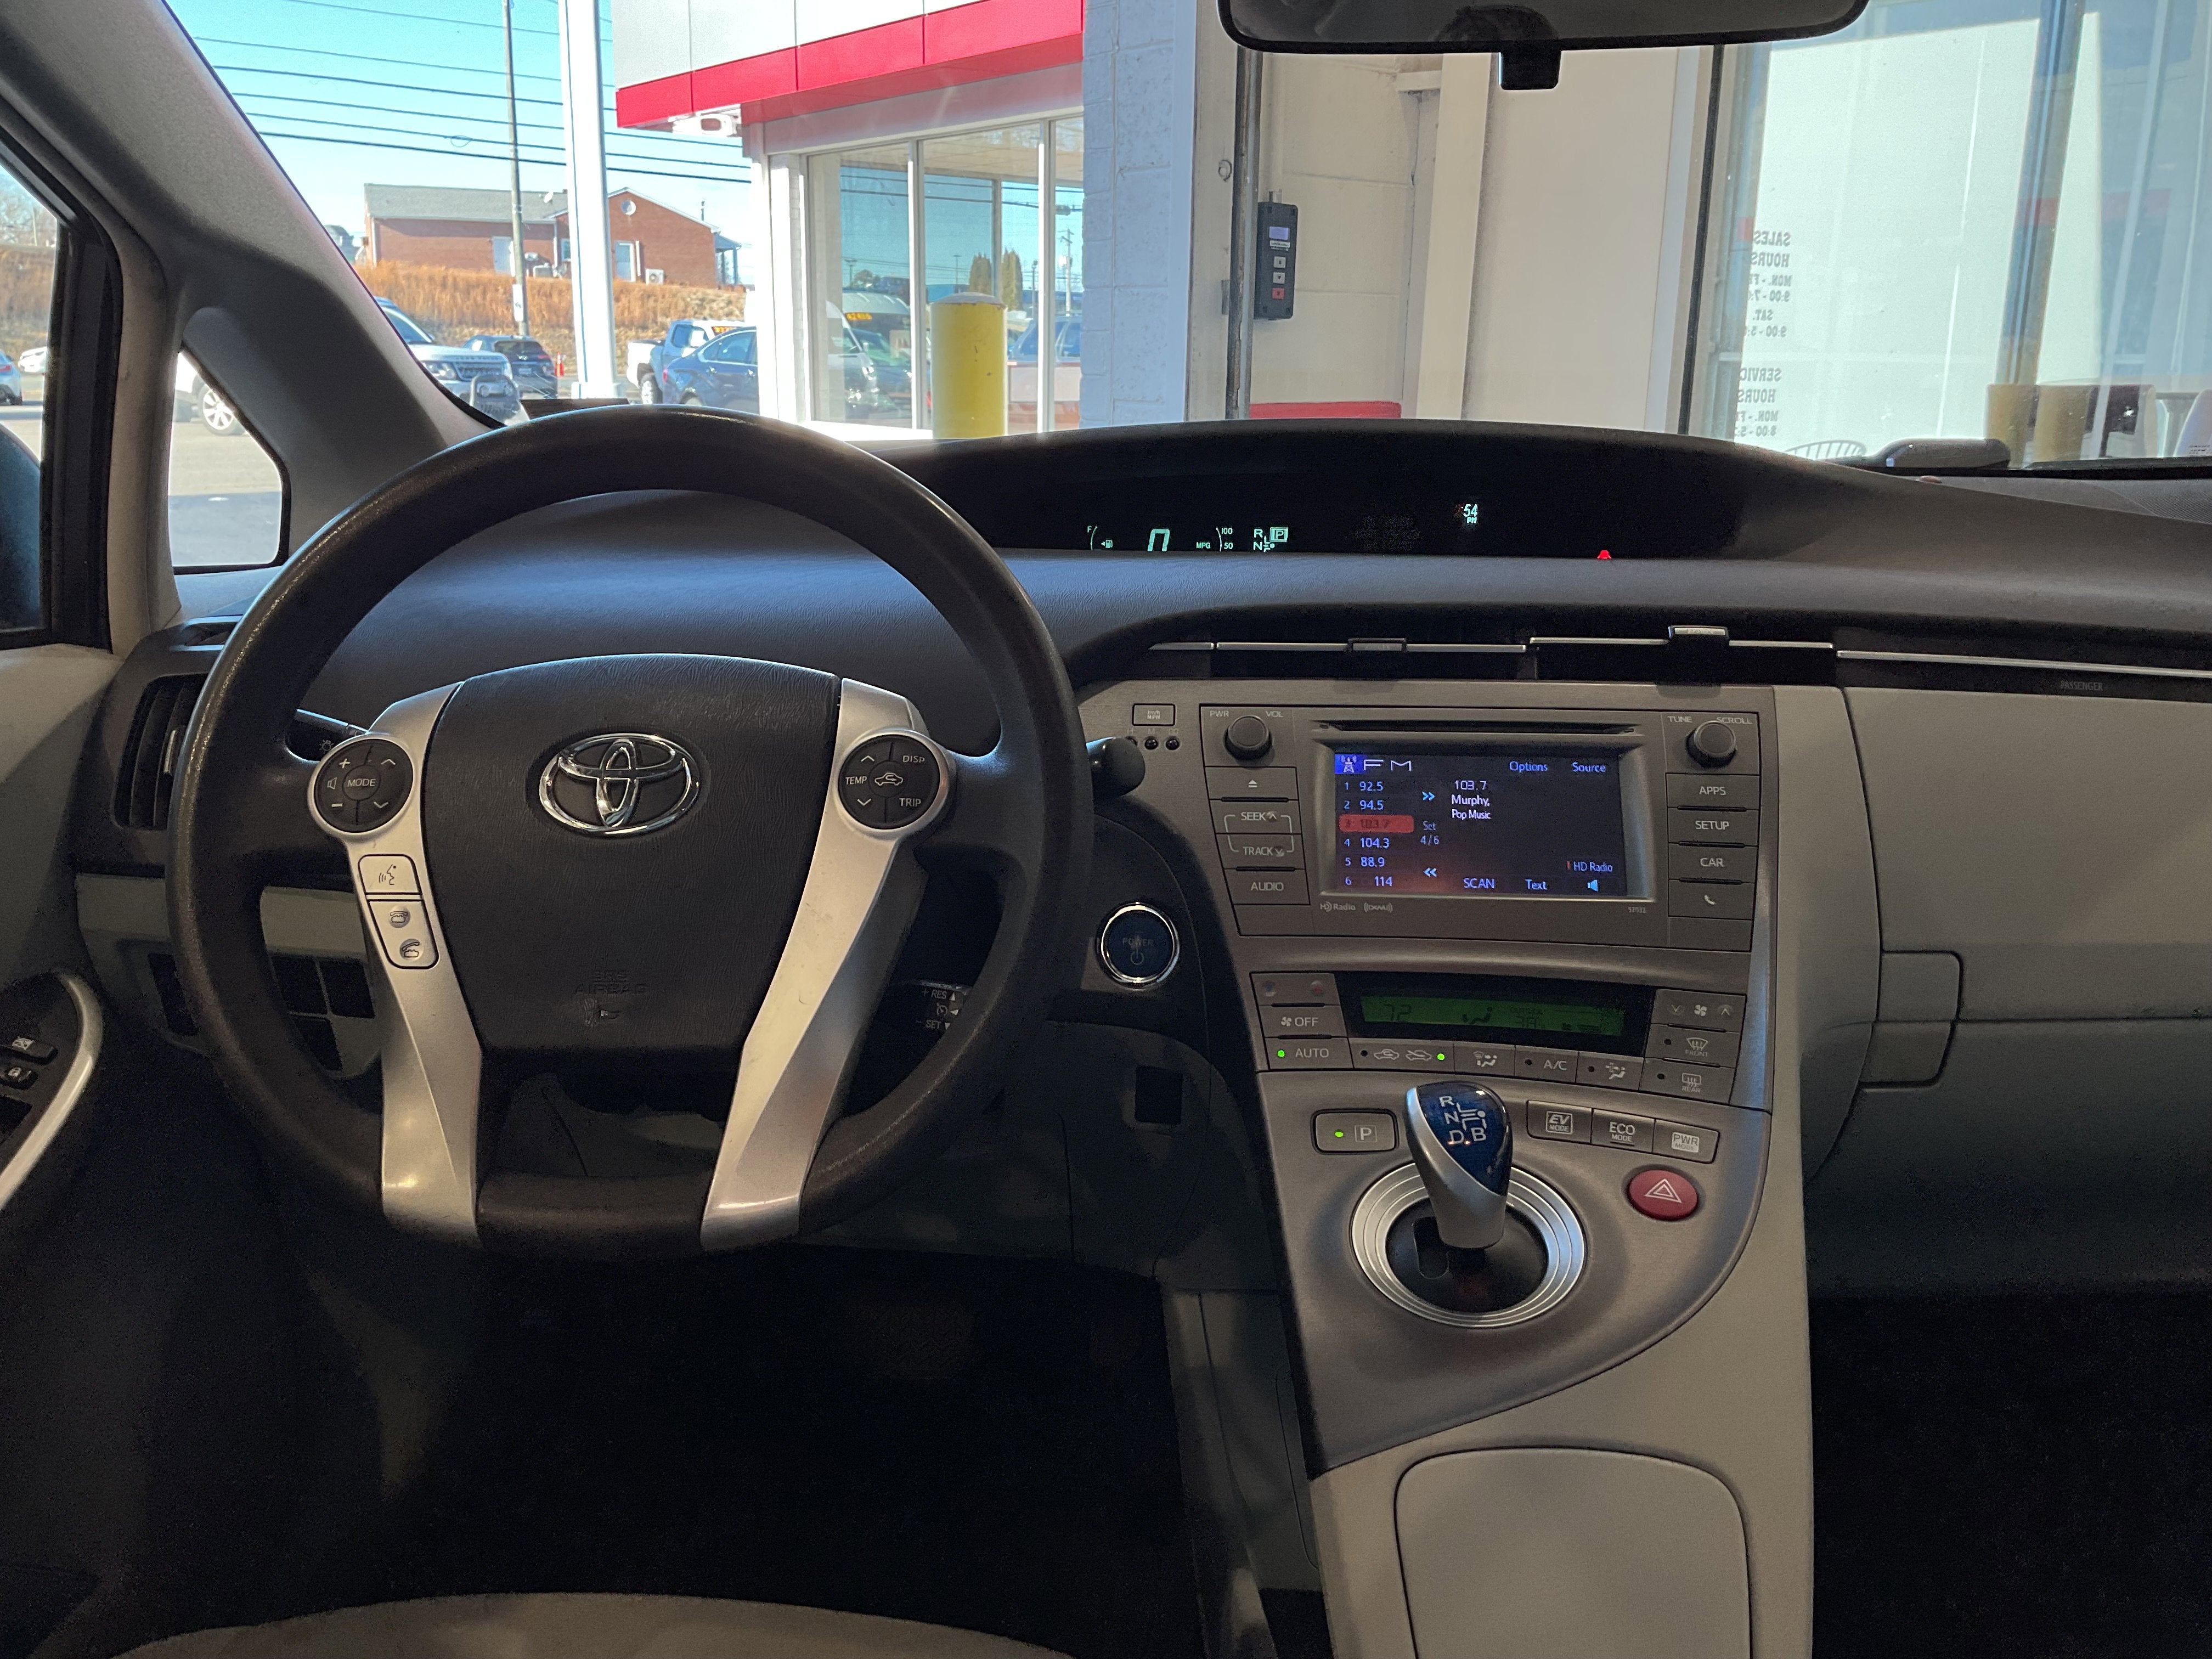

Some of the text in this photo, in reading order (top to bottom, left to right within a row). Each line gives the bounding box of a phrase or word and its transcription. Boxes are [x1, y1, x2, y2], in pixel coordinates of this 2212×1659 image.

[1221, 527, 1233, 535] 100
[1254, 528, 1263, 538] R
[1253, 541, 1262, 550] N
[2060, 681, 2103, 691] PASSENGER
[1363, 759, 1412, 772] FM
[1509, 760, 1548, 772] Options
[1571, 761, 1606, 772] Source
[347, 778, 376, 787] MODE
[845, 776, 867, 785] TEMP
[1454, 780, 1487, 791] 103.7
[1345, 781, 1384, 792] 1 92.5
[1699, 786, 1726, 795] APPS
[899, 798, 921, 807] TRIP
[1344, 800, 1384, 811] 2 94.5
[1240, 812, 1266, 821] SEEK
[1452, 809, 1491, 820] Pop Music
[1423, 821, 1436, 831] Set
[1695, 821, 1729, 830] SETUP
[1344, 837, 1390, 849] 4 104.3
[1420, 835, 1440, 846] 4/6
[1243, 847, 1273, 856] TRACK
[1345, 856, 1385, 867] 5 88.9
[1573, 861, 1613, 872] HD Radio
[1700, 858, 1724, 867] CAR
[1250, 882, 1284, 891] AUDIO
[1345, 876, 1393, 887] 6 114
[1463, 878, 1495, 889] SCAN
[1525, 878, 1548, 890] Text
[1333, 902, 1356, 911] Radio
[931, 989, 947, 999] RES
[926, 1019, 941, 1029] SET
[1295, 1017, 1319, 1027] OFF
[1295, 1048, 1329, 1058] AUTO
[1685, 1049, 1708, 1057] FRONT
[1544, 1060, 1567, 1070] A/C
[1439, 1096, 1455, 1107] R
[1443, 1111, 1460, 1124] N
[1548, 1114, 1570, 1125] EV
[1549, 1124, 1570, 1132] MODE
[1609, 1121, 1635, 1136] ECO
[1359, 1127, 1372, 1141] P
[1449, 1127, 1487, 1144] D B
[1611, 1133, 1633, 1143] MODE
[1673, 1134, 1699, 1146] PWR
